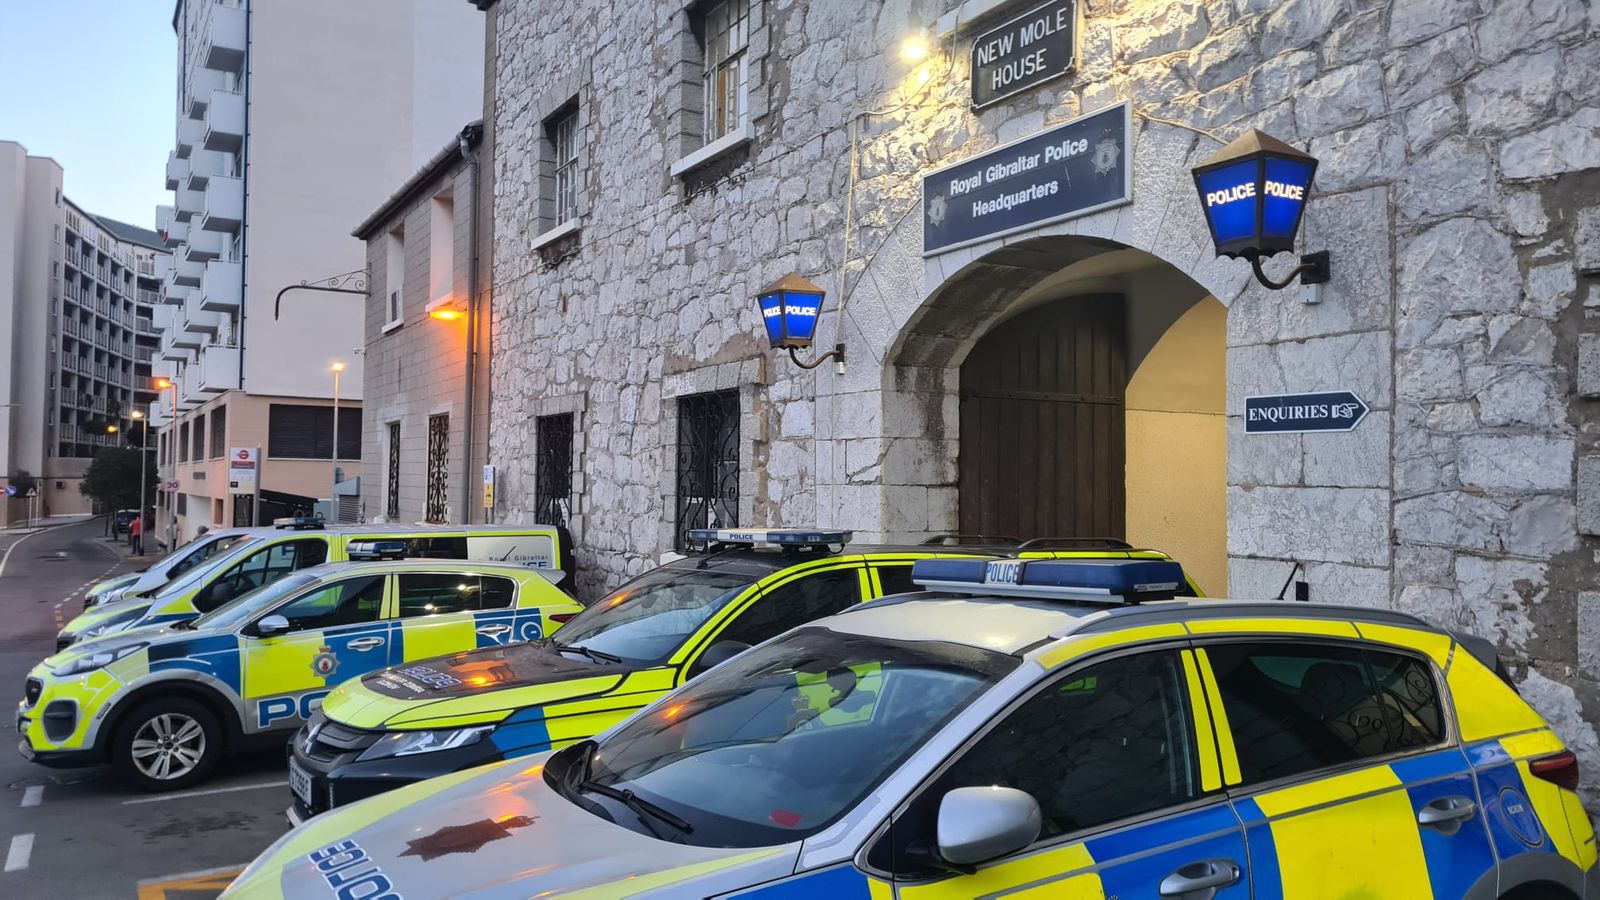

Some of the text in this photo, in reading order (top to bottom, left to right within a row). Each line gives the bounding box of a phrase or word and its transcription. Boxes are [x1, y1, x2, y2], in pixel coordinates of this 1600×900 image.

[977, 7, 1067, 67] NEW MOLE
[992, 48, 1047, 90] HOUSE
[950, 138, 1088, 195] Royal Gibraltar Police
[972, 180, 1059, 217] Headquarters
[1207, 182, 1256, 207] POLICE
[1264, 180, 1304, 200] POLICE
[785, 305, 816, 316] POLICE
[1248, 404, 1328, 423] ENQUIRIES
[986, 563, 1019, 583] POLICE
